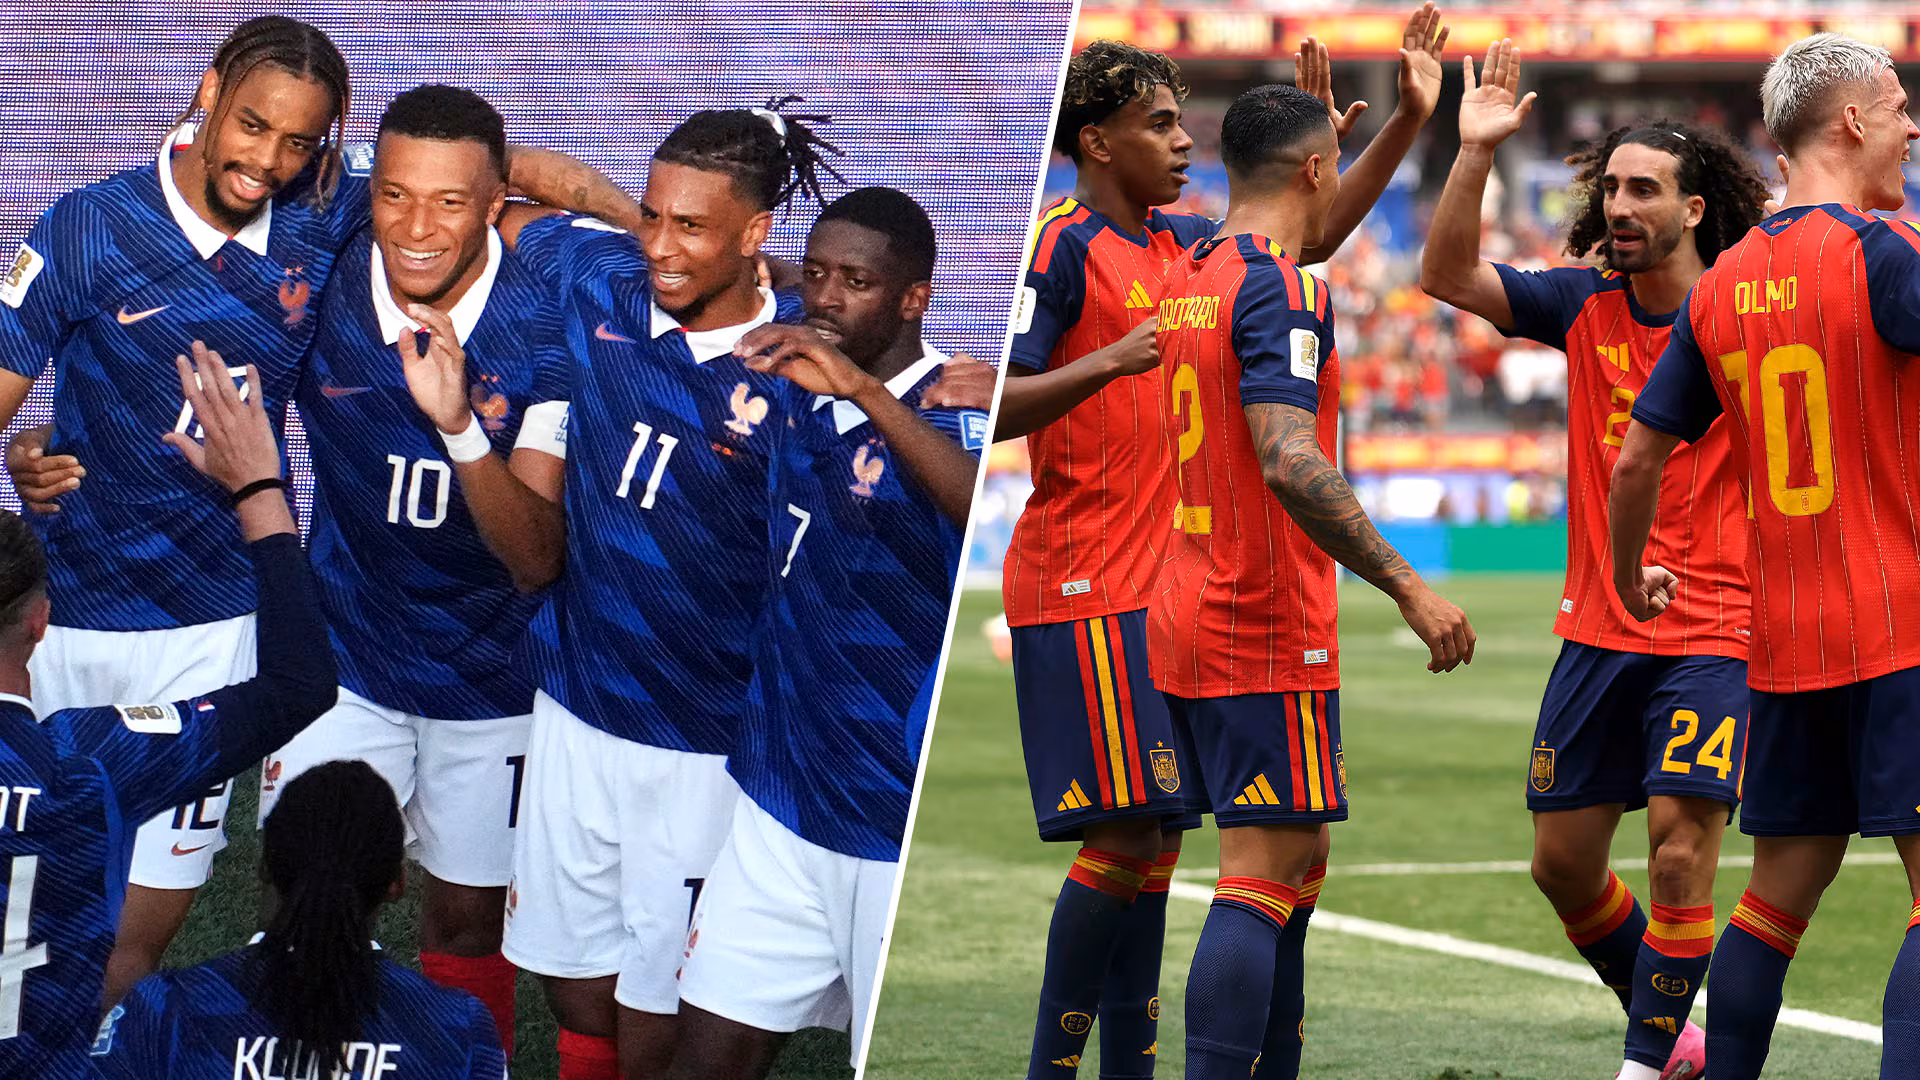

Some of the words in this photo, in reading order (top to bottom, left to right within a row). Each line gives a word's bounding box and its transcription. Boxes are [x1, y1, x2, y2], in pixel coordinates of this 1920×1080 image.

[1734, 275, 1798, 315] OLMO
[174, 366, 251, 439] 1
[387, 453, 452, 529] 10
[615, 421, 679, 510] 11
[780, 502, 811, 578] 7
[1661, 709, 1736, 780] 24
